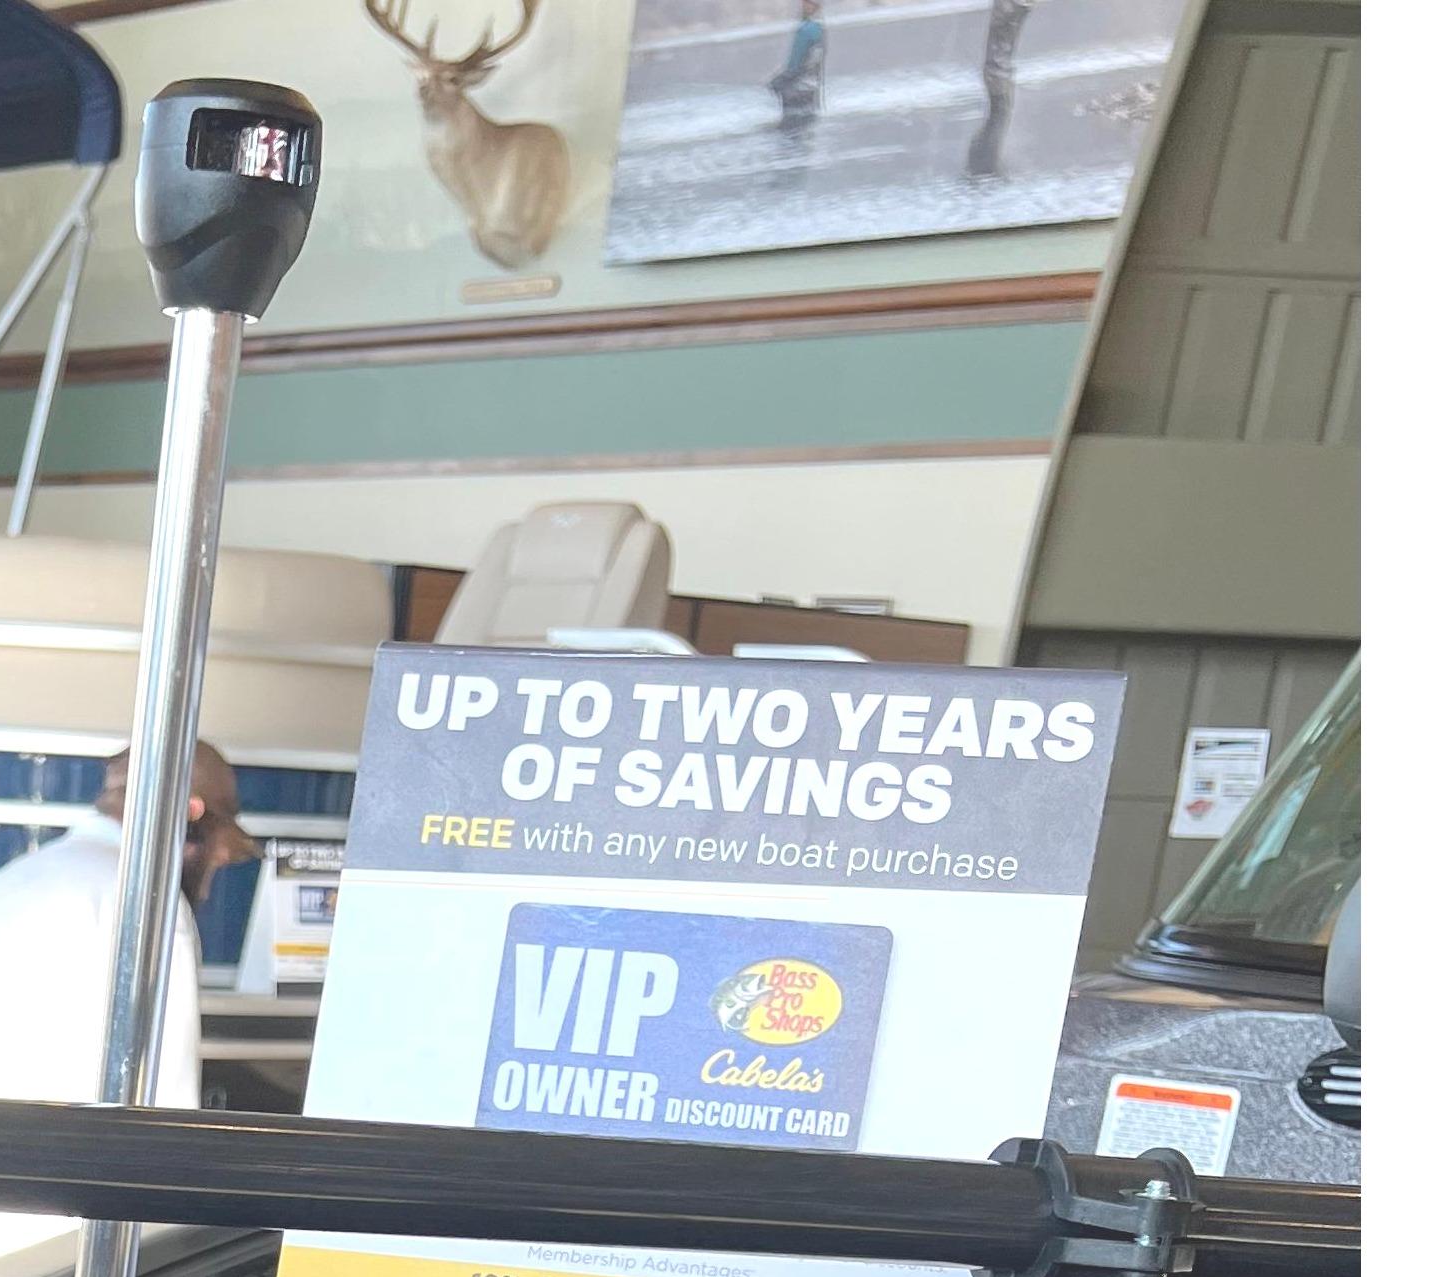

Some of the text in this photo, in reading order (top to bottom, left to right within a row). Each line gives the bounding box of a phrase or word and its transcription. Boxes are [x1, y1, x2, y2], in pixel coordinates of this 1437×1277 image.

[396, 672, 1096, 763] UP TO TWO YEARS
[501, 742, 953, 824] OF SAVINGS
[420, 814, 1019, 881] FREE with any new boat purchase
[514, 943, 680, 1057] VIP
[765, 985, 804, 1011] Pro
[769, 963, 819, 990] Bass
[760, 1007, 825, 1038] Shops
[493, 1059, 851, 1138] OWNER DISCOUNT CARD
[700, 1048, 825, 1093] Cabela's
[527, 1245, 636, 1273] Membership
